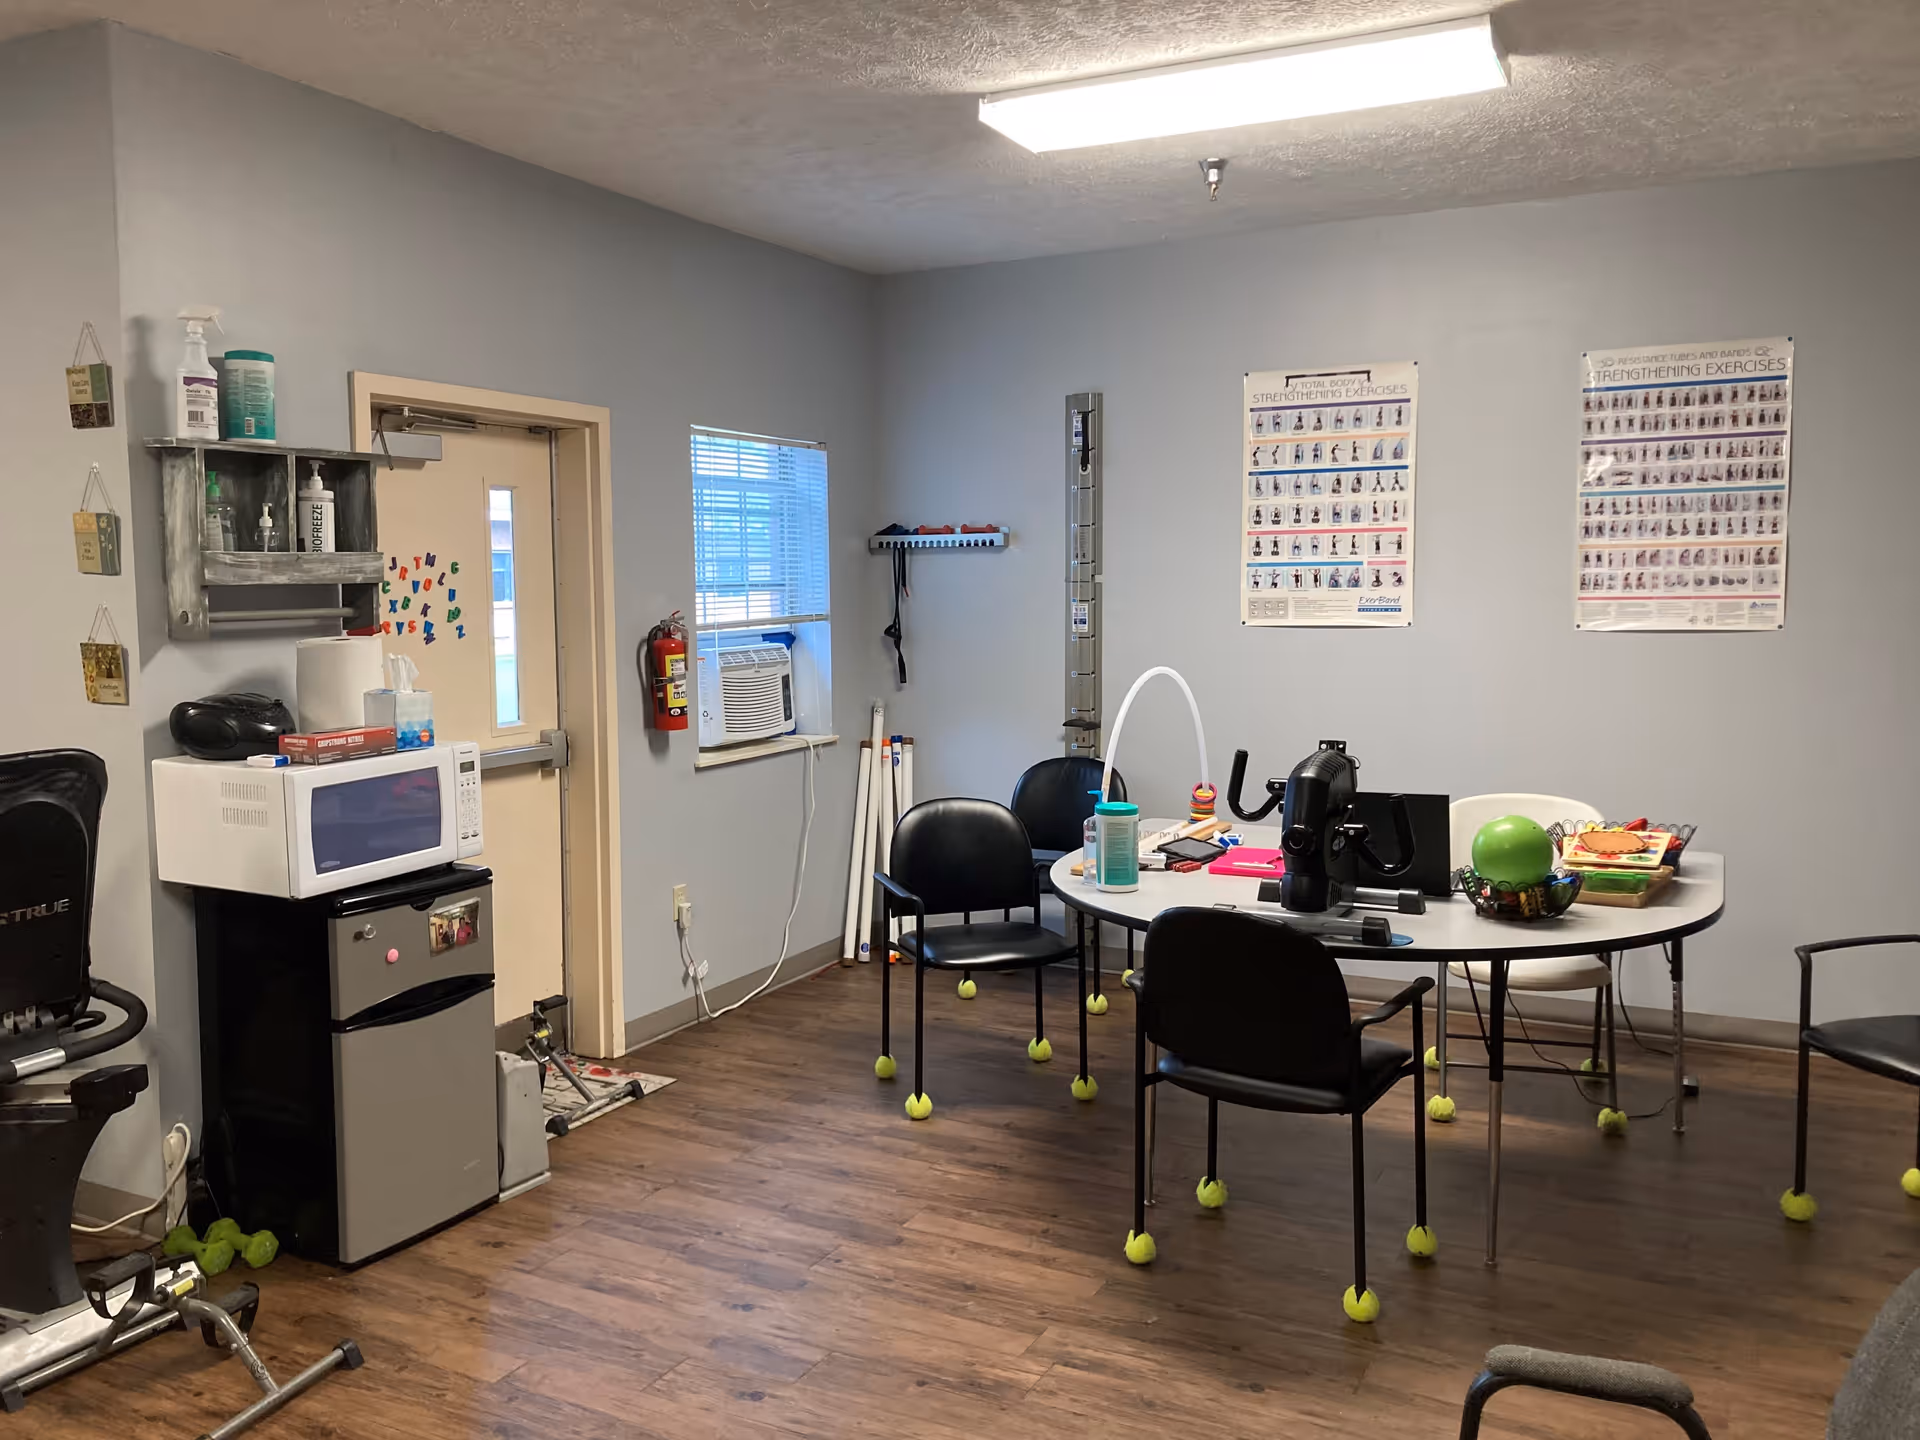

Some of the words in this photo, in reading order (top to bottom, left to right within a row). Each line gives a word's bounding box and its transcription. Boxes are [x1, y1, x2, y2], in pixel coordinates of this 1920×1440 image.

[1699, 351, 1718, 360] AND
[1586, 364, 1700, 384] STRENGTHENING
[1705, 358, 1786, 376] EXERCISES
[1301, 382, 1326, 390] TOTAL
[1330, 379, 1356, 388] BODY
[1252, 389, 1342, 403] STRENGTHENING
[1345, 384, 1408, 398] EXERCISES
[312, 503, 323, 552] BIOFREEZE
[389, 557, 397, 571] J
[413, 556, 422, 571] T
[389, 600, 398, 613] X
[408, 620, 417, 634] S
[10, 898, 69, 922] TRUE
